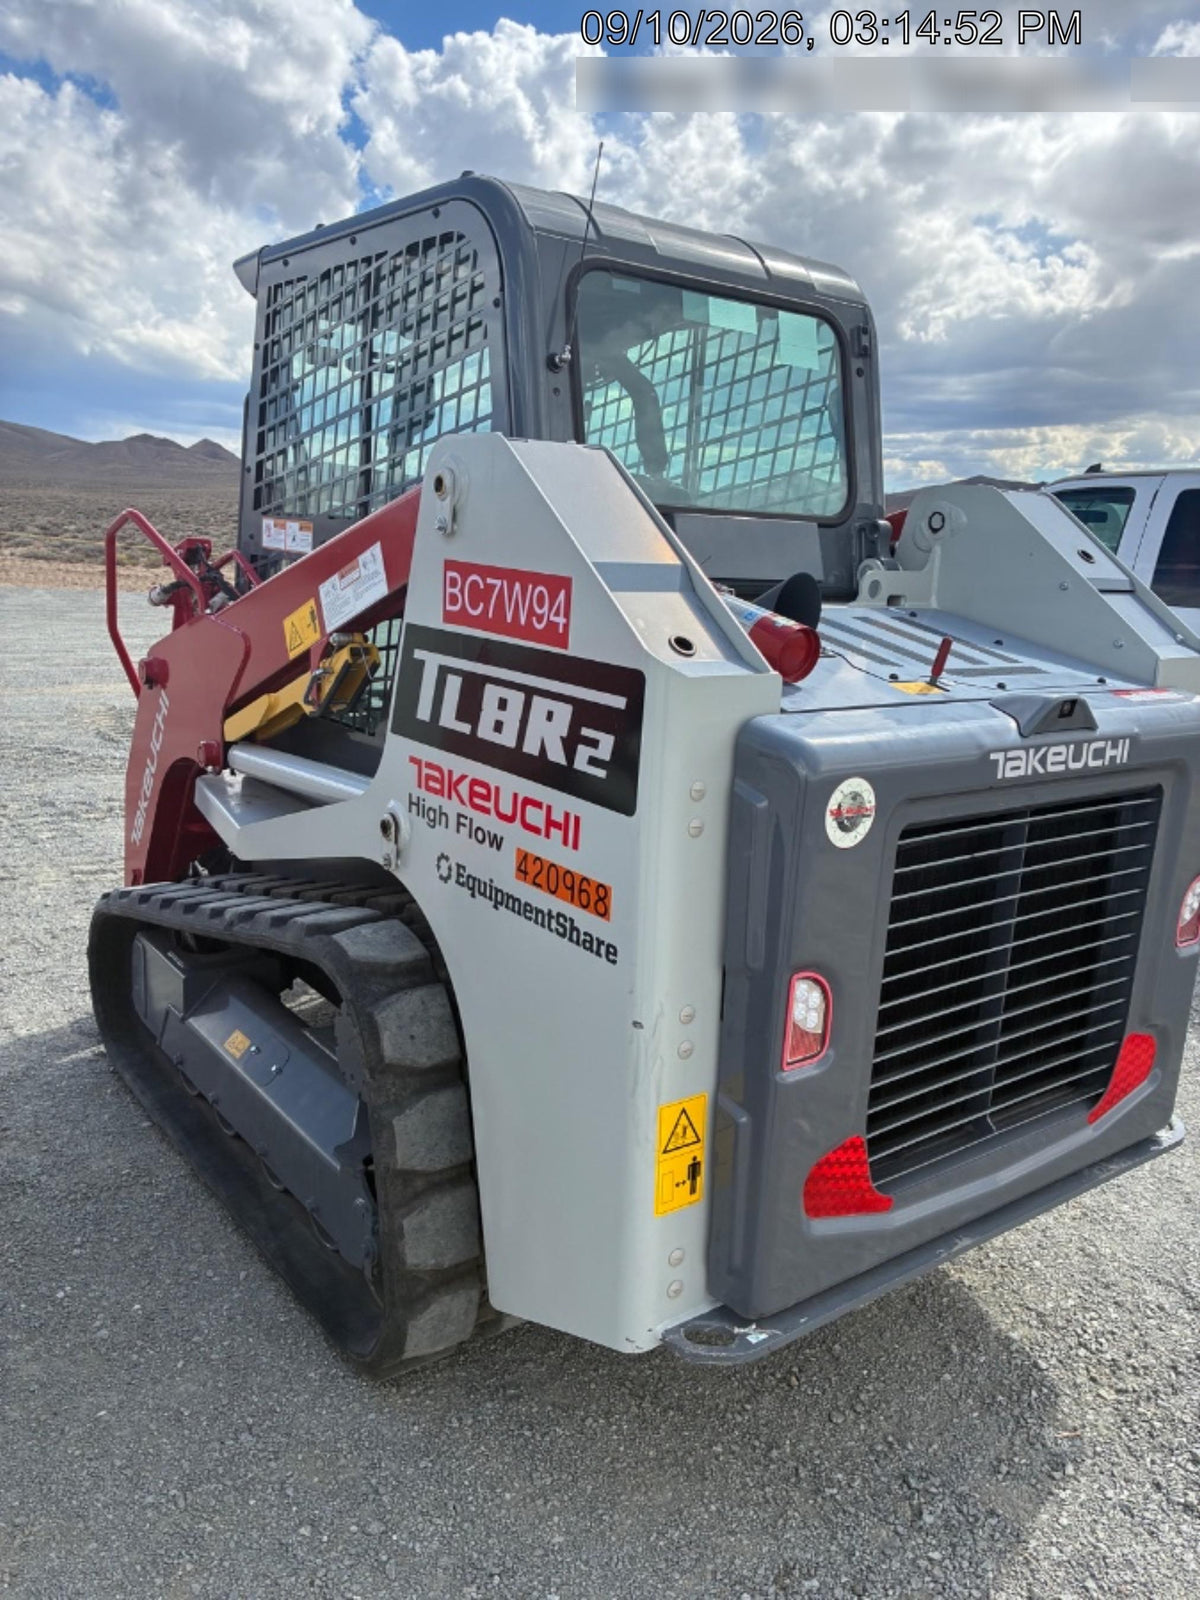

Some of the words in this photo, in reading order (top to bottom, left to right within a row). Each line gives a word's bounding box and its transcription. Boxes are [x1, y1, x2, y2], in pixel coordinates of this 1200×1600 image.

[444, 570, 568, 634] BC7W94
[407, 792, 450, 830] High
[455, 813, 504, 852] Flow
[455, 862, 619, 966] EquipmentShare
[516, 852, 611, 920] 420968
